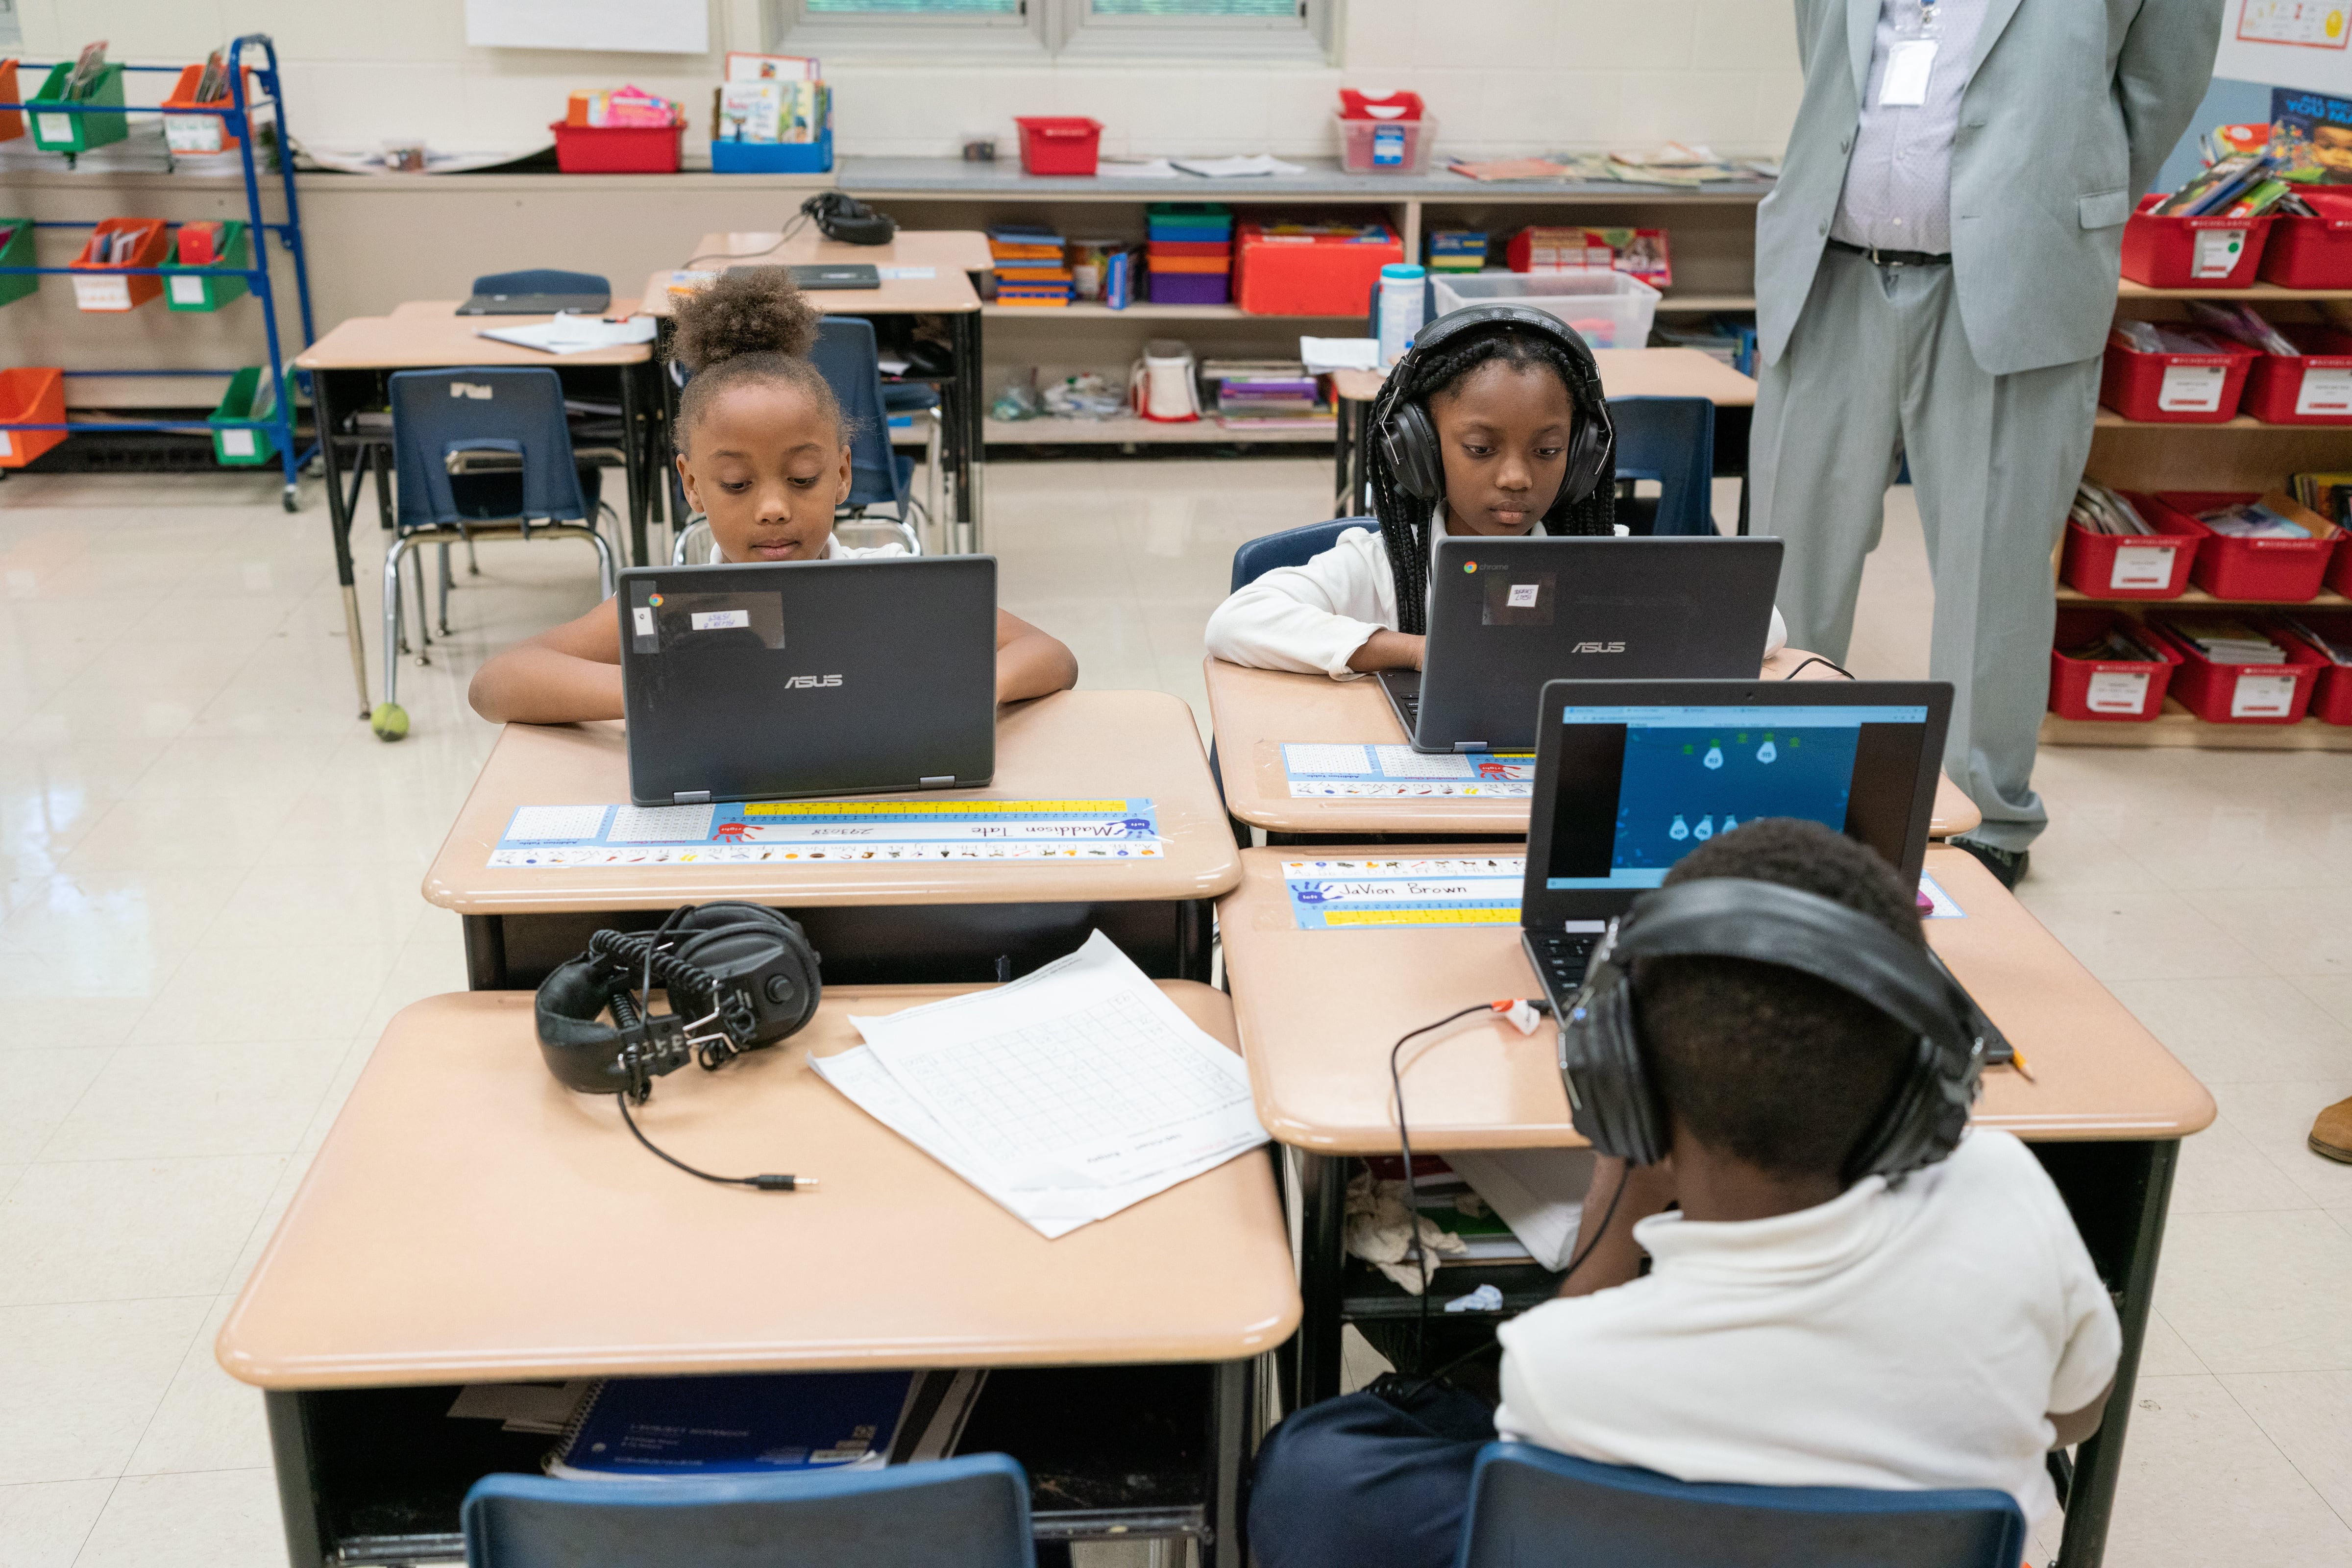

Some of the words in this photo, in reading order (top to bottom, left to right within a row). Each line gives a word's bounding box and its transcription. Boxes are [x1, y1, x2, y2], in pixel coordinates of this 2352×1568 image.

[1571, 642, 1626, 653] ASUS
[784, 674, 843, 689] ASUS
[971, 827, 1013, 837] Tate
[1025, 826, 1112, 836] Maddison
[1339, 883, 1395, 895] JaVion
[1408, 882, 1467, 894] Brown
